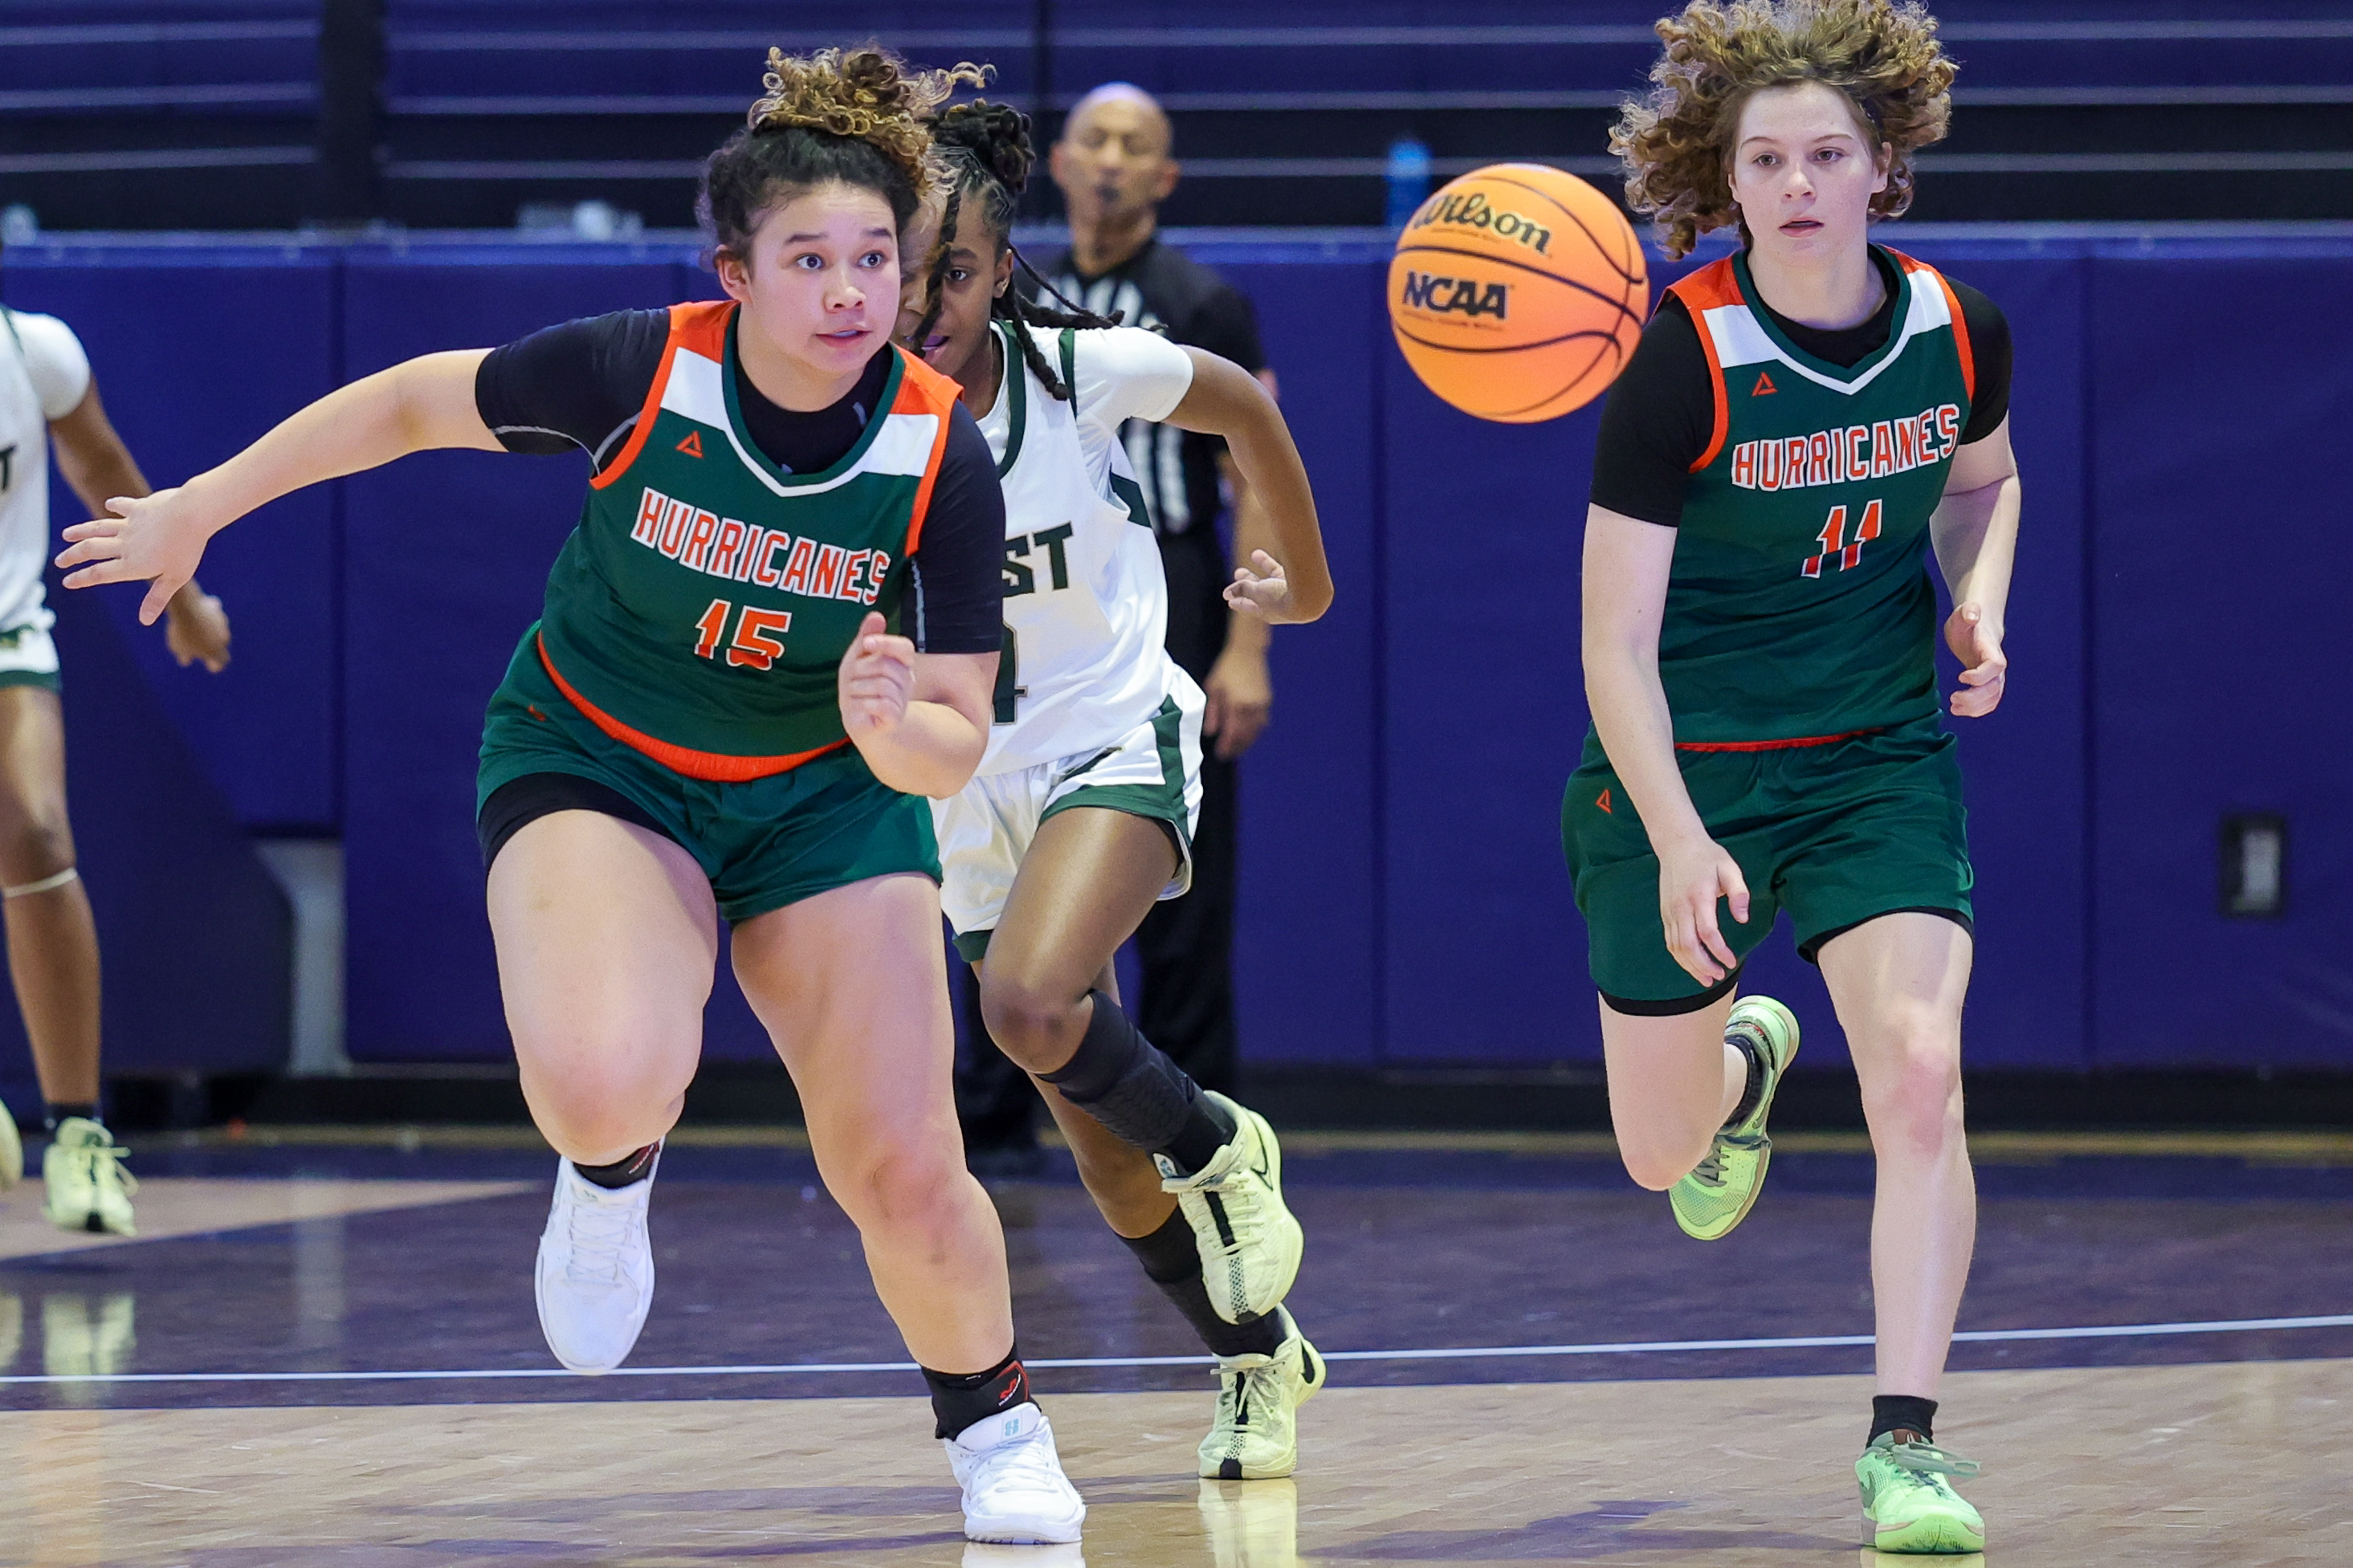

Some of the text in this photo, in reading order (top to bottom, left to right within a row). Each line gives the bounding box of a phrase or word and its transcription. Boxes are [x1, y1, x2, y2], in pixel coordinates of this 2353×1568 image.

[1414, 192, 1551, 255] Wilson
[1402, 270, 1507, 320] NCAA
[1731, 403, 1959, 491] HURRICANES
[630, 487, 891, 605] HURRICANES
[1800, 498, 1882, 579] 11
[694, 598, 793, 670] 15
